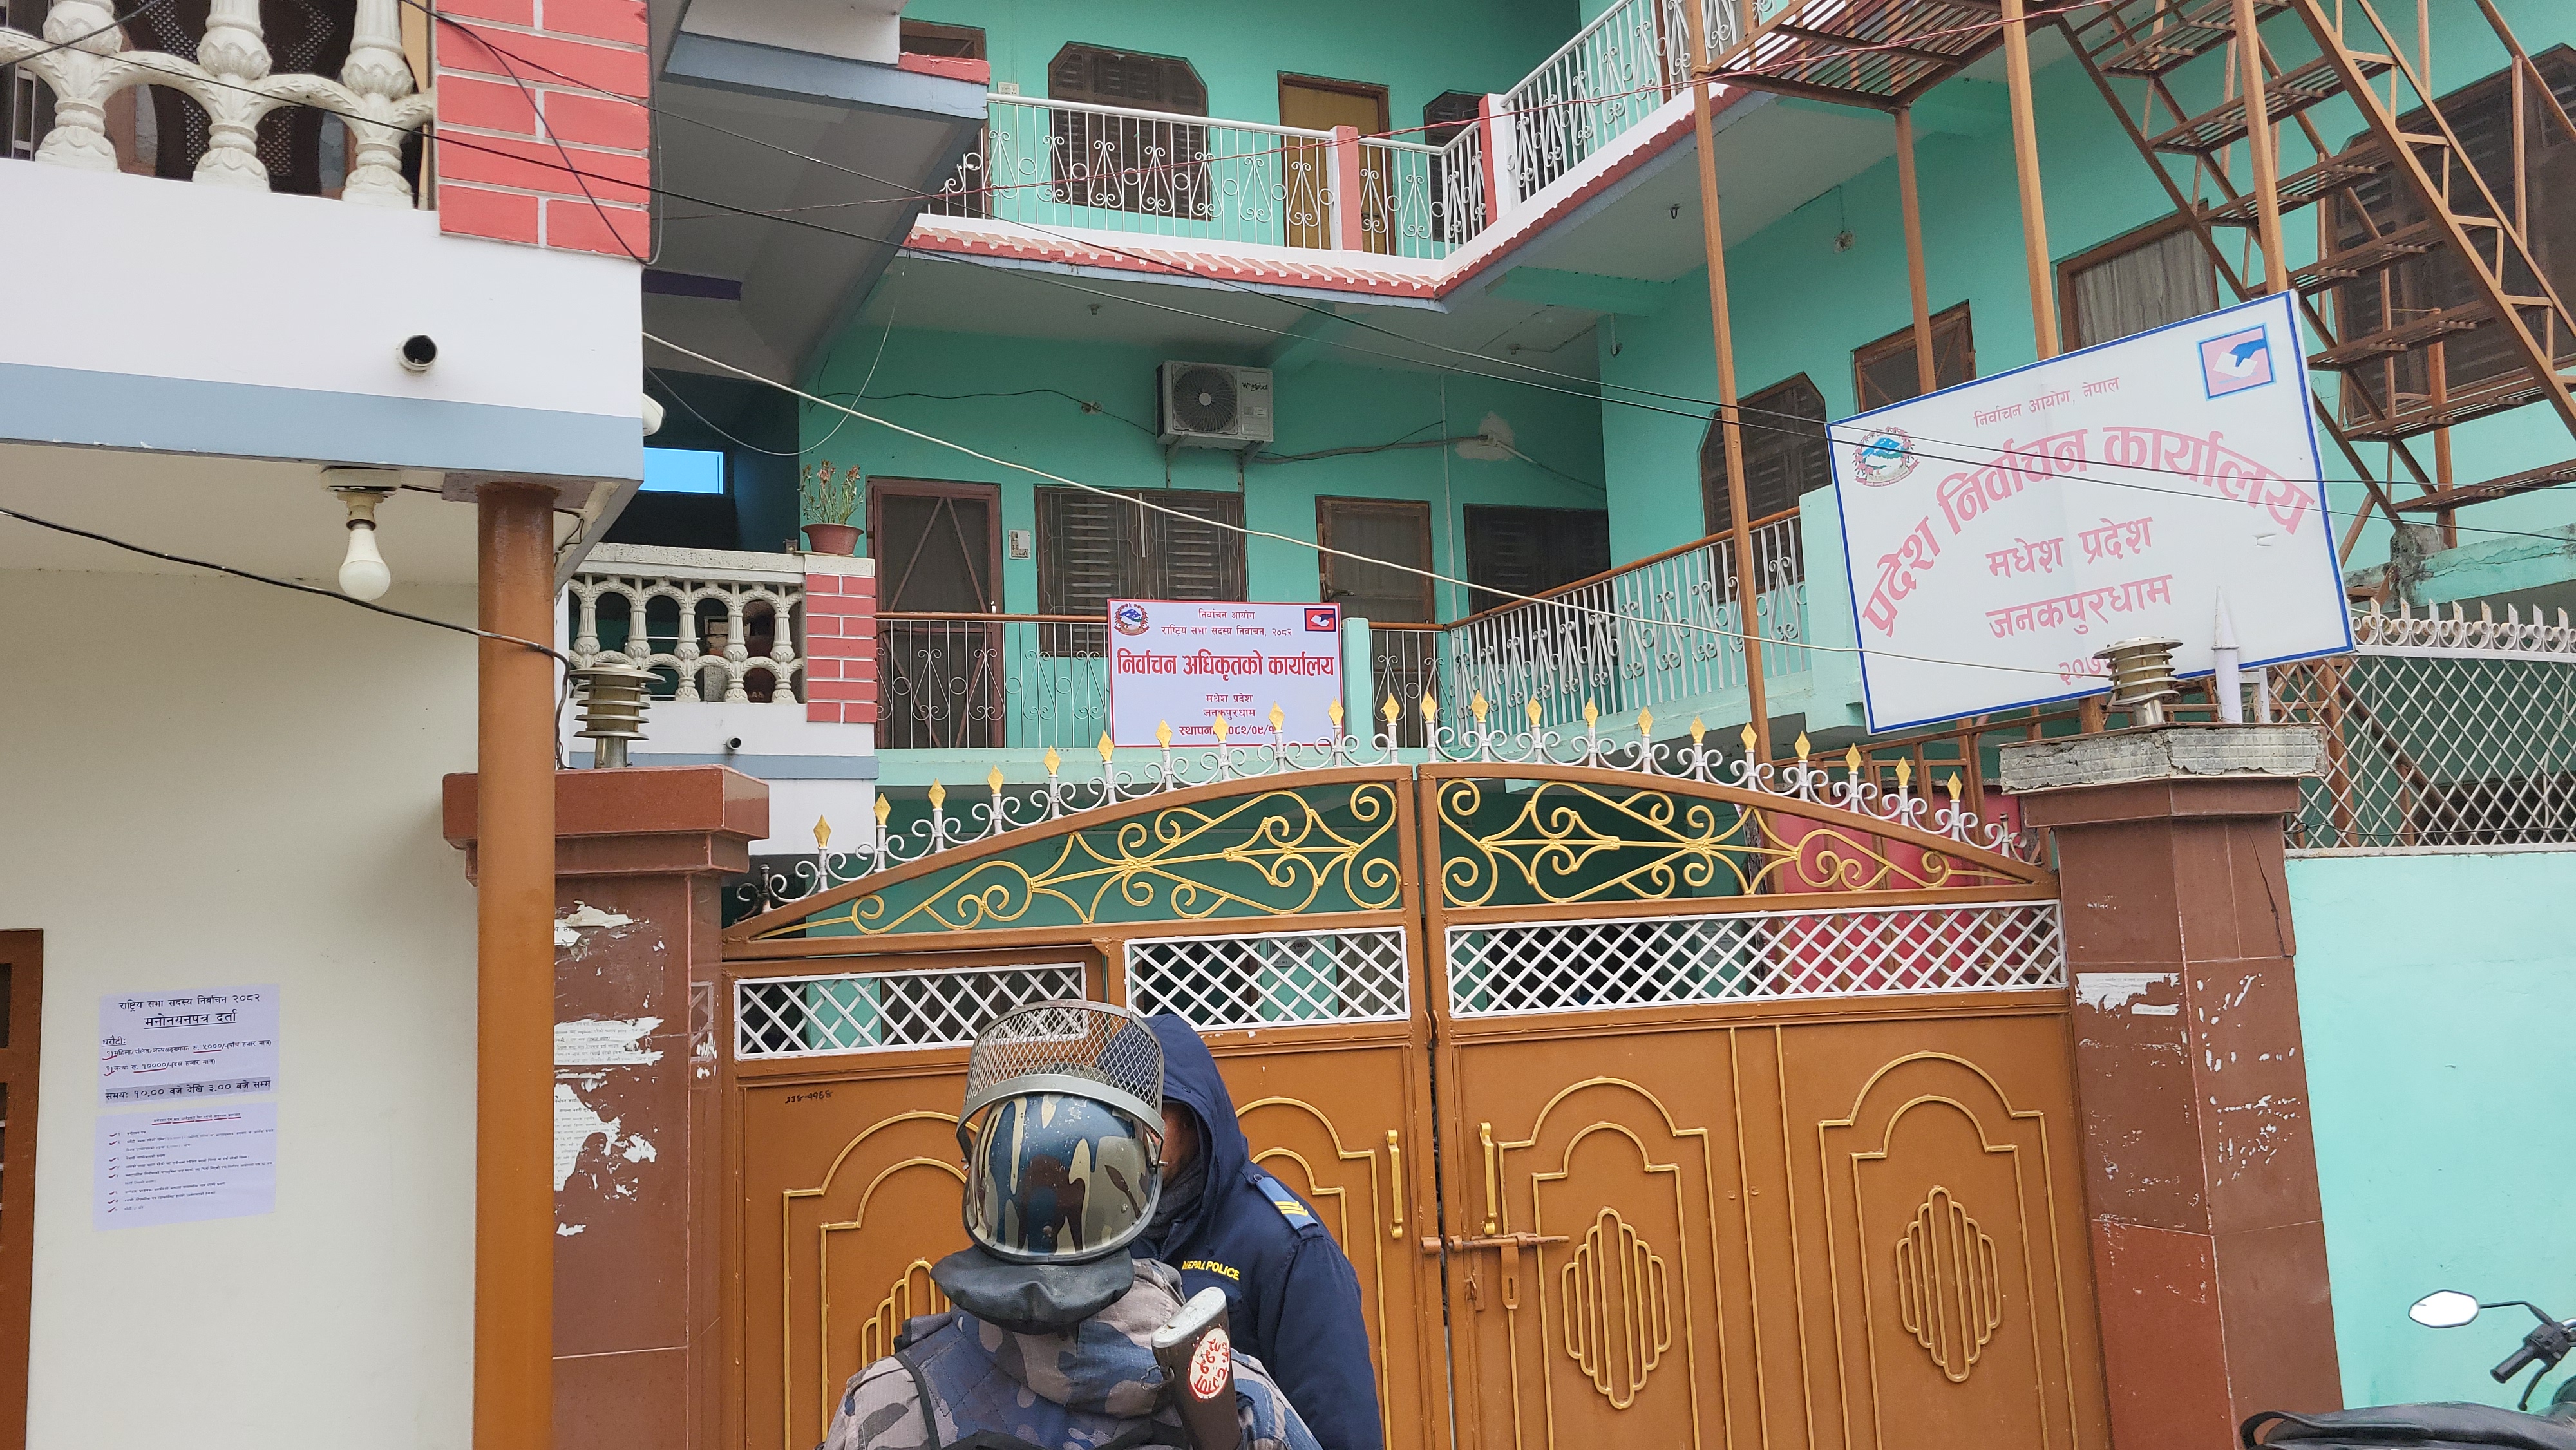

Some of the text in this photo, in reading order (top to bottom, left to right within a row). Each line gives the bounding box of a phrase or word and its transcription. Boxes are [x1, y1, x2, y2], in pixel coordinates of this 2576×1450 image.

[1974, 376, 2120, 428] निर्वाचन आयोग, नेपाल
[1862, 426, 2315, 637] प्रदेश निर्वाचन कार्यालय
[1985, 516, 2154, 578] मधेश प्रदेश
[1198, 608, 1255, 619] निर्वाचन आयोग
[1985, 573, 2174, 639] जनकपुरधाम
[1161, 626, 1187, 636] राष्ट्रिय
[1211, 627, 1233, 636] सदस्य
[1236, 626, 1267, 637] निर्वाचन,
[1272, 628, 1293, 637] २०८२
[1117, 648, 1334, 681] निर्वाचन अधिकृतको कार्यालय
[2058, 653, 2112, 686] २०७
[1206, 693, 1253, 703] मधेश प्रदेश
[118, 994, 260, 1012] राष्ट्रिय सभा सदस्य निर्वाचन २०८२
[144, 1008, 238, 1028] मनोनयनपत्र दर्ता
[186, 1084, 204, 1093] देखि
[1182, 1260, 1240, 1281] NEPAL POLICE
